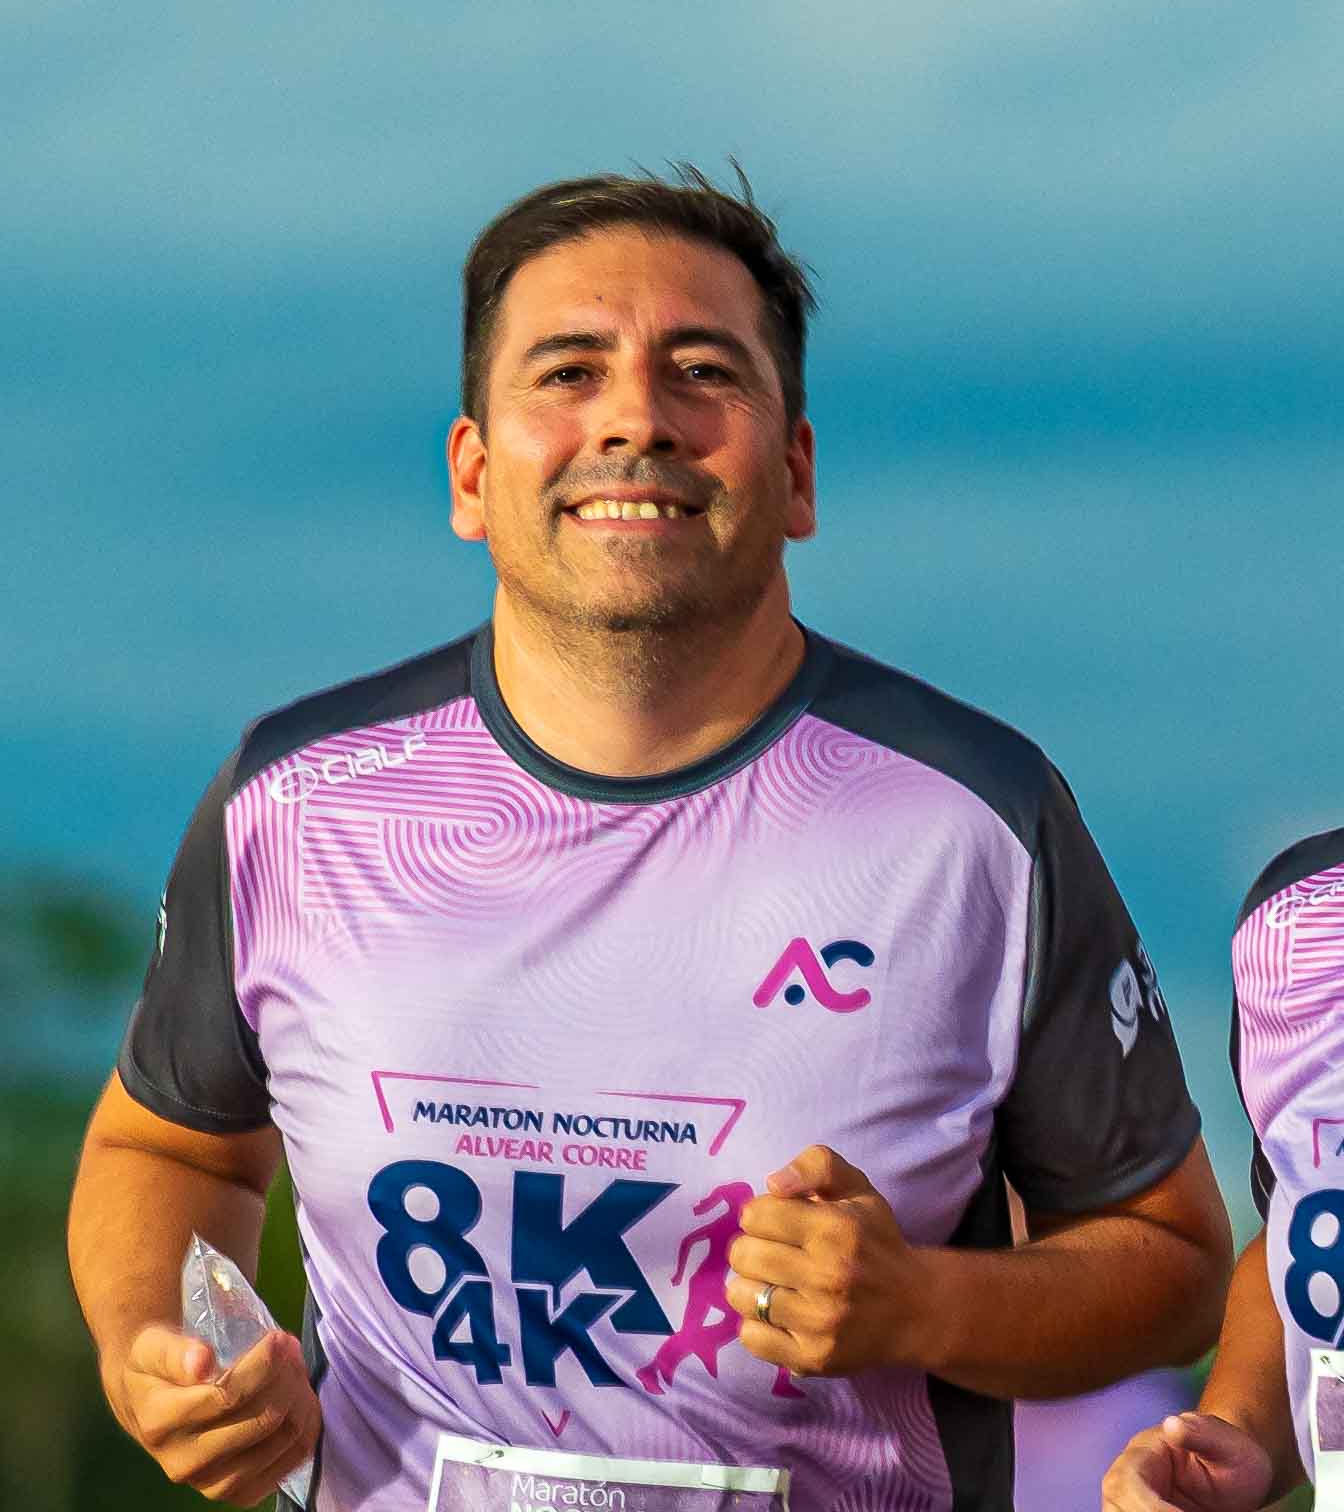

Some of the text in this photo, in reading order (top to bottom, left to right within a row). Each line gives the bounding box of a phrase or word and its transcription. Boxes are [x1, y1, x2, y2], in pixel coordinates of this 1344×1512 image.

[412, 1100, 698, 1145] MARATON NOCTURNA
[454, 1133, 648, 1171] ALVEAR CORRE
[367, 1159, 683, 1336] 8K
[432, 1280, 632, 1388] 4K
[511, 1474, 626, 1509] Maratón
